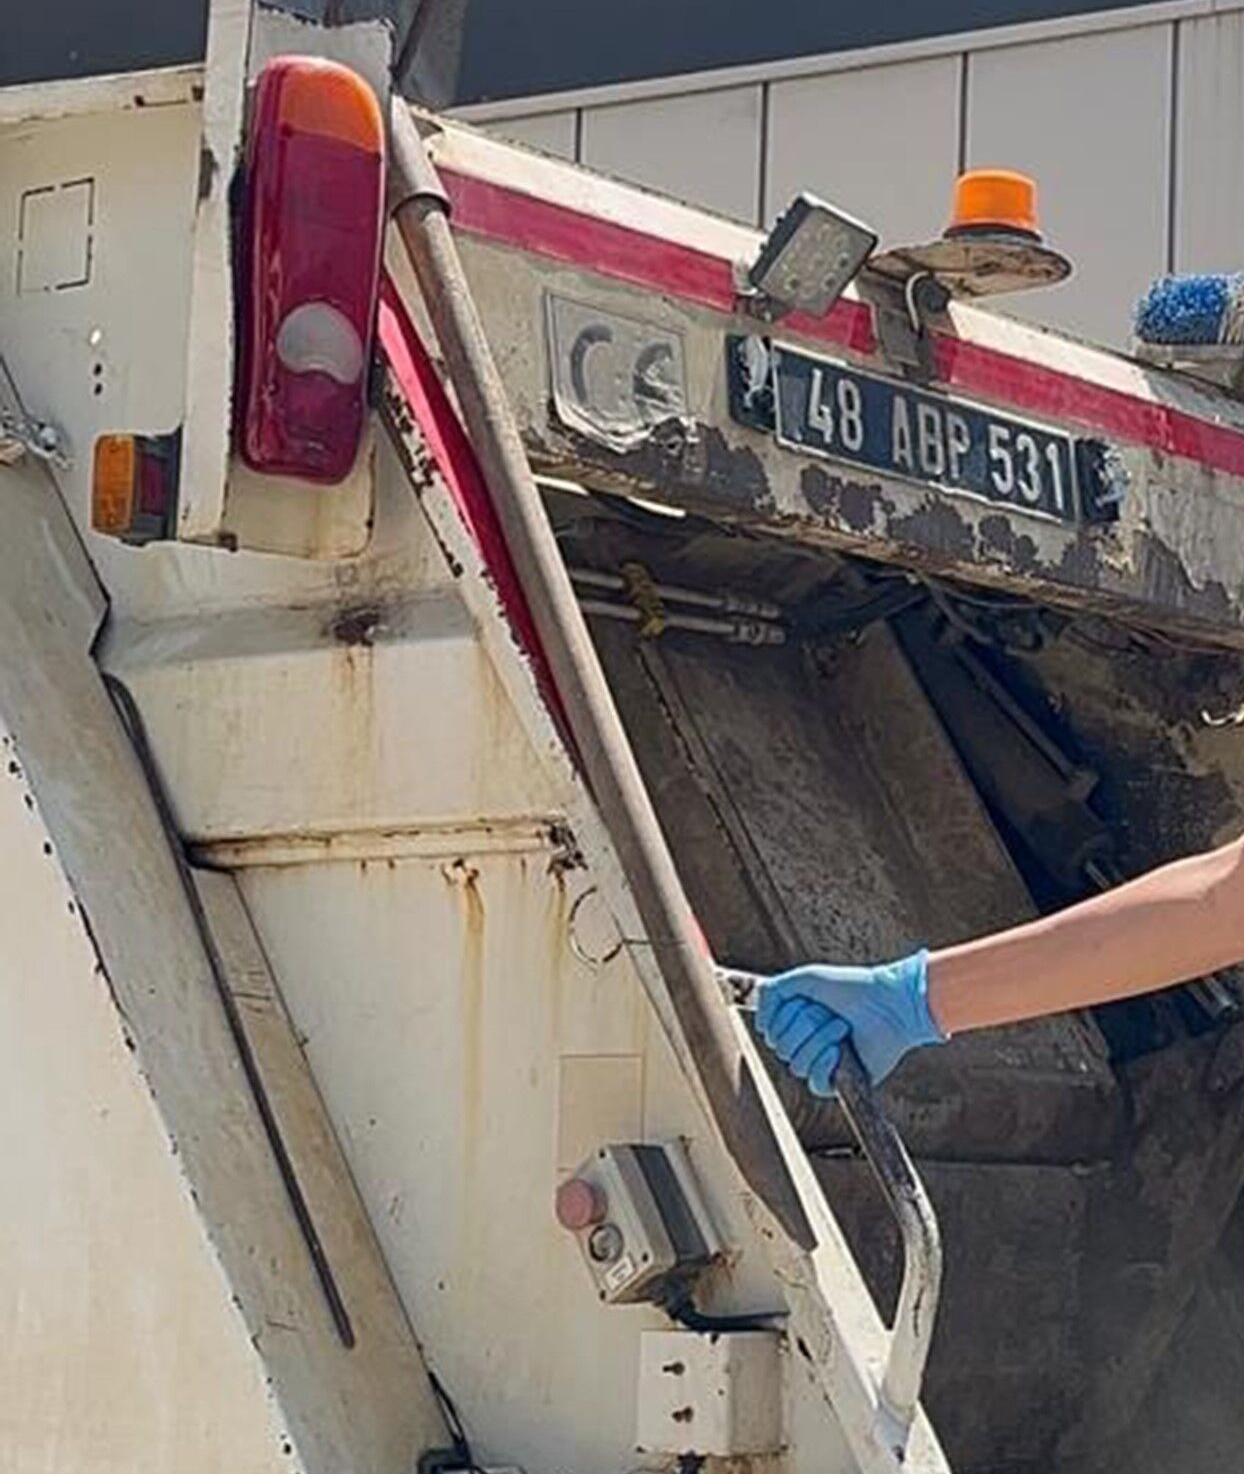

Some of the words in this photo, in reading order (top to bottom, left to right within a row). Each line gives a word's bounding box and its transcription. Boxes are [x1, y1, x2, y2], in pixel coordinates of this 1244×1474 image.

[808, 367, 863, 452] 48
[891, 395, 971, 480] ABP
[988, 423, 1064, 512] 531
